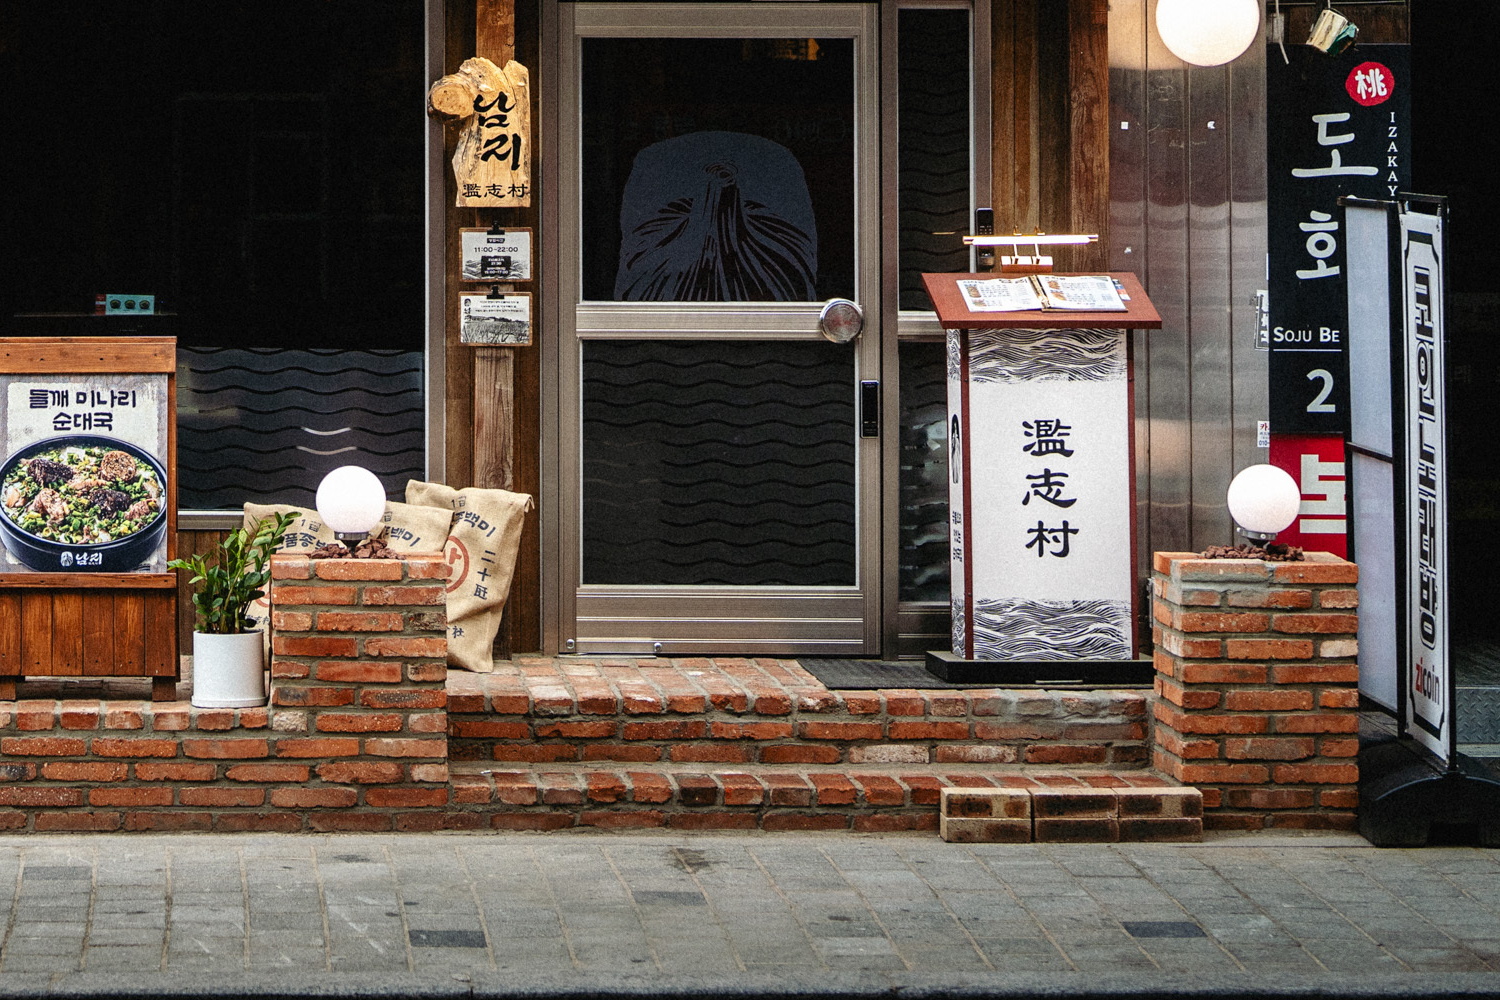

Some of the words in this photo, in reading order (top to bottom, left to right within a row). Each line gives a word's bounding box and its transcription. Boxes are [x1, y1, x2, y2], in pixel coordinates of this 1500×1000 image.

[1355, 68, 1388, 99] 桃
[29, 389, 71, 409] 들깨
[75, 389, 137, 408] 미나리
[52, 412, 114, 432] 순대국
[1021, 418, 1080, 558] 濫志村
